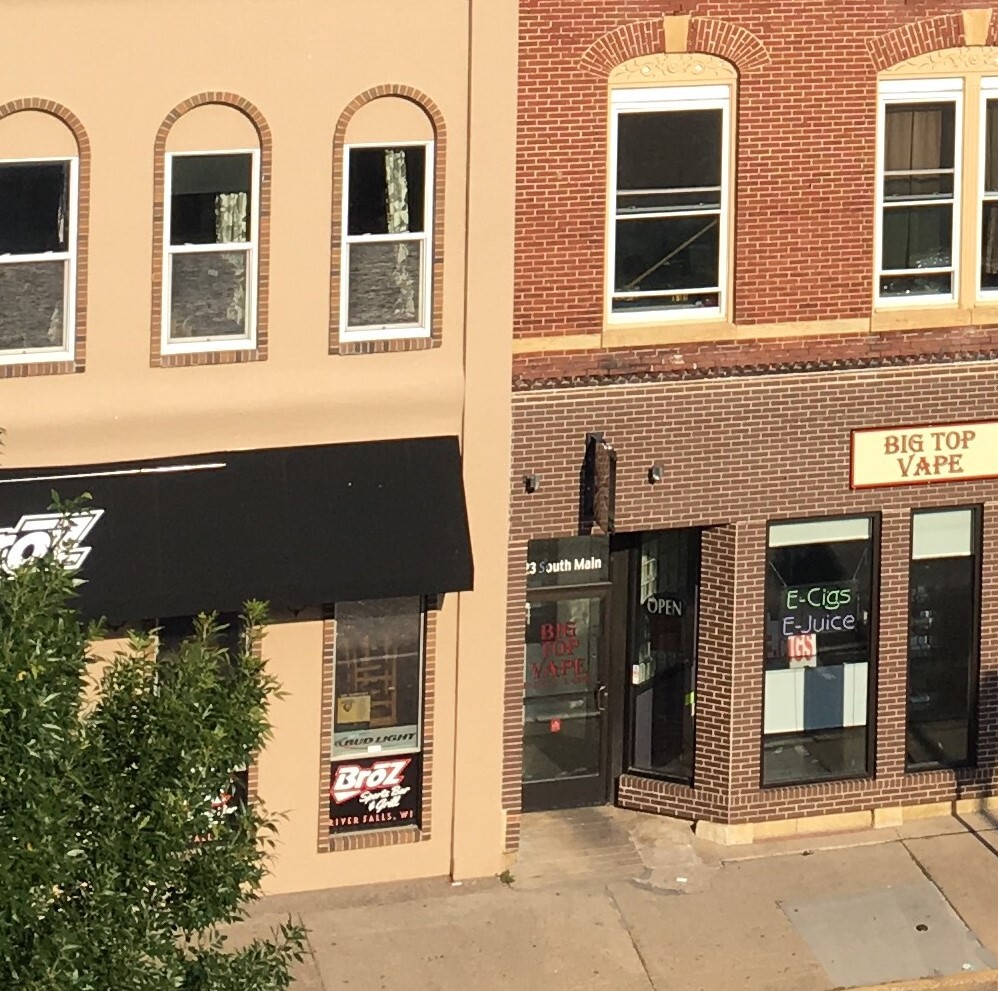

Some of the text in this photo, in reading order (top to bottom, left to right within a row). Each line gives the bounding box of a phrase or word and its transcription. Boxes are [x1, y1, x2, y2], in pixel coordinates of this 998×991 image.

[884, 430, 976, 455] BIG TOP
[898, 454, 964, 477] VAPE
[539, 559, 571, 574] South
[574, 556, 602, 570] Main
[647, 597, 682, 616] OPEN
[787, 588, 851, 609] E-Cigs
[540, 621, 577, 641] BIG
[783, 614, 855, 636] E-Juice
[542, 638, 579, 658] TOP
[530, 658, 584, 679] VAPE
[376, 733, 416, 744] LIGHT
[391, 785, 411, 796] Bar
[375, 795, 401, 813] Grill
[329, 816, 359, 827] RIVER
[400, 810, 414, 819] WI
